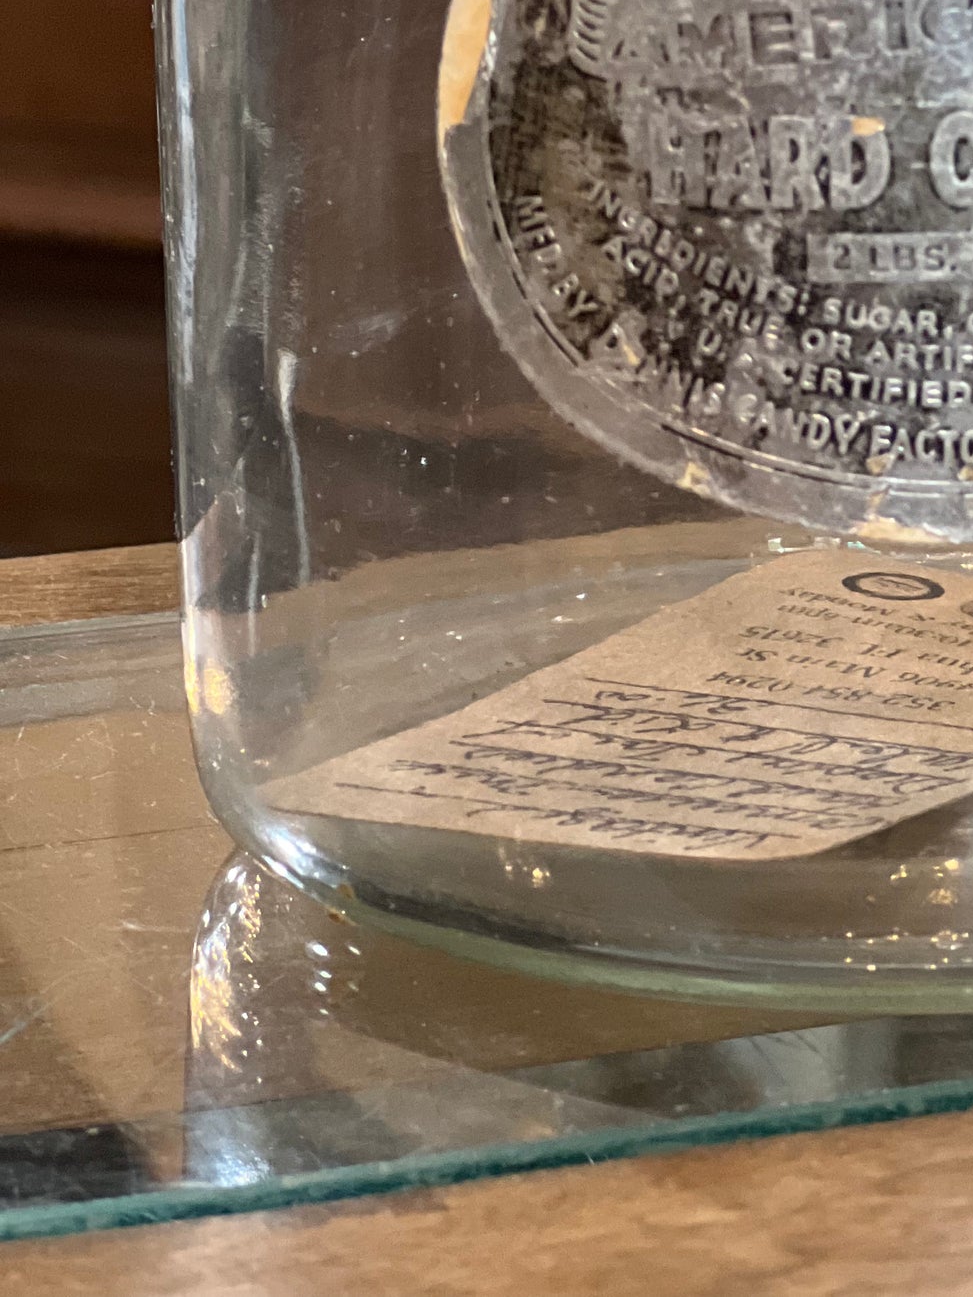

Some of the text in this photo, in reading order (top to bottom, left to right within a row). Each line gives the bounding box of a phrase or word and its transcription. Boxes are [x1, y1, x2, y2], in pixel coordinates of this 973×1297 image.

[650, 113, 892, 210] HARD
[833, 243, 852, 271] 2
[700, 287, 784, 350] TRUE
[801, 325, 853, 361] OR
[821, 297, 954, 341] SUGAR,
[553, 272, 599, 318] BY
[598, 316, 727, 416] DNIS
[734, 392, 862, 456] CANDY
[776, 356, 973, 410] CERTIFIED
[778, 587, 896, 617] Monday
[735, 646, 777, 663] St
[738, 626, 843, 649] 32615
[786, 653, 885, 680] Main
[705, 671, 956, 713] 352-854-0294
